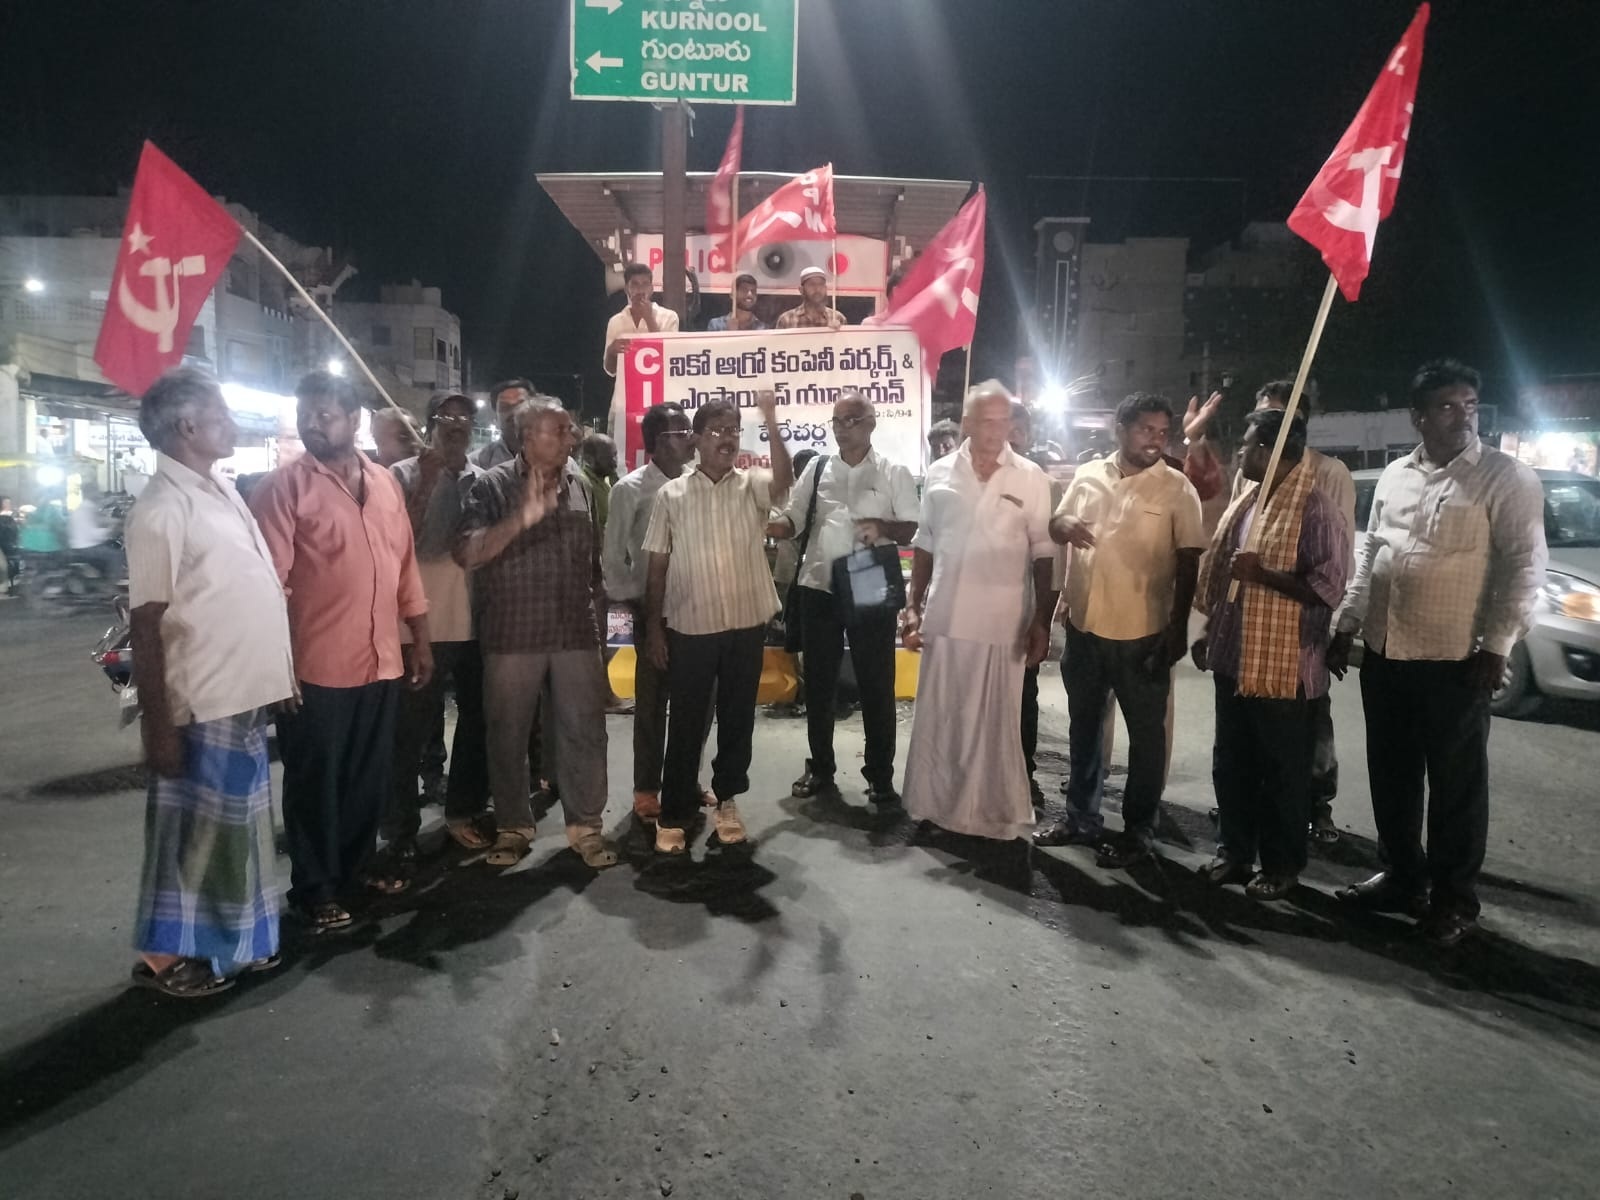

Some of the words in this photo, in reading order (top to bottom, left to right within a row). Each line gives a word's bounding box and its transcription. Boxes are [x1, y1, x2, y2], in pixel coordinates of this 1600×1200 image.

[641, 11, 768, 32] KURNOOL
[641, 37, 751, 61] గుంటూరు
[640, 72, 749, 93] GUNTUR
[669, 348, 712, 377] నికో
[715, 346, 767, 379] ఆగ్రో
[771, 346, 835, 374] కంపెనీ
[839, 344, 898, 379] వర్కర్స్
[902, 353, 915, 370] &
